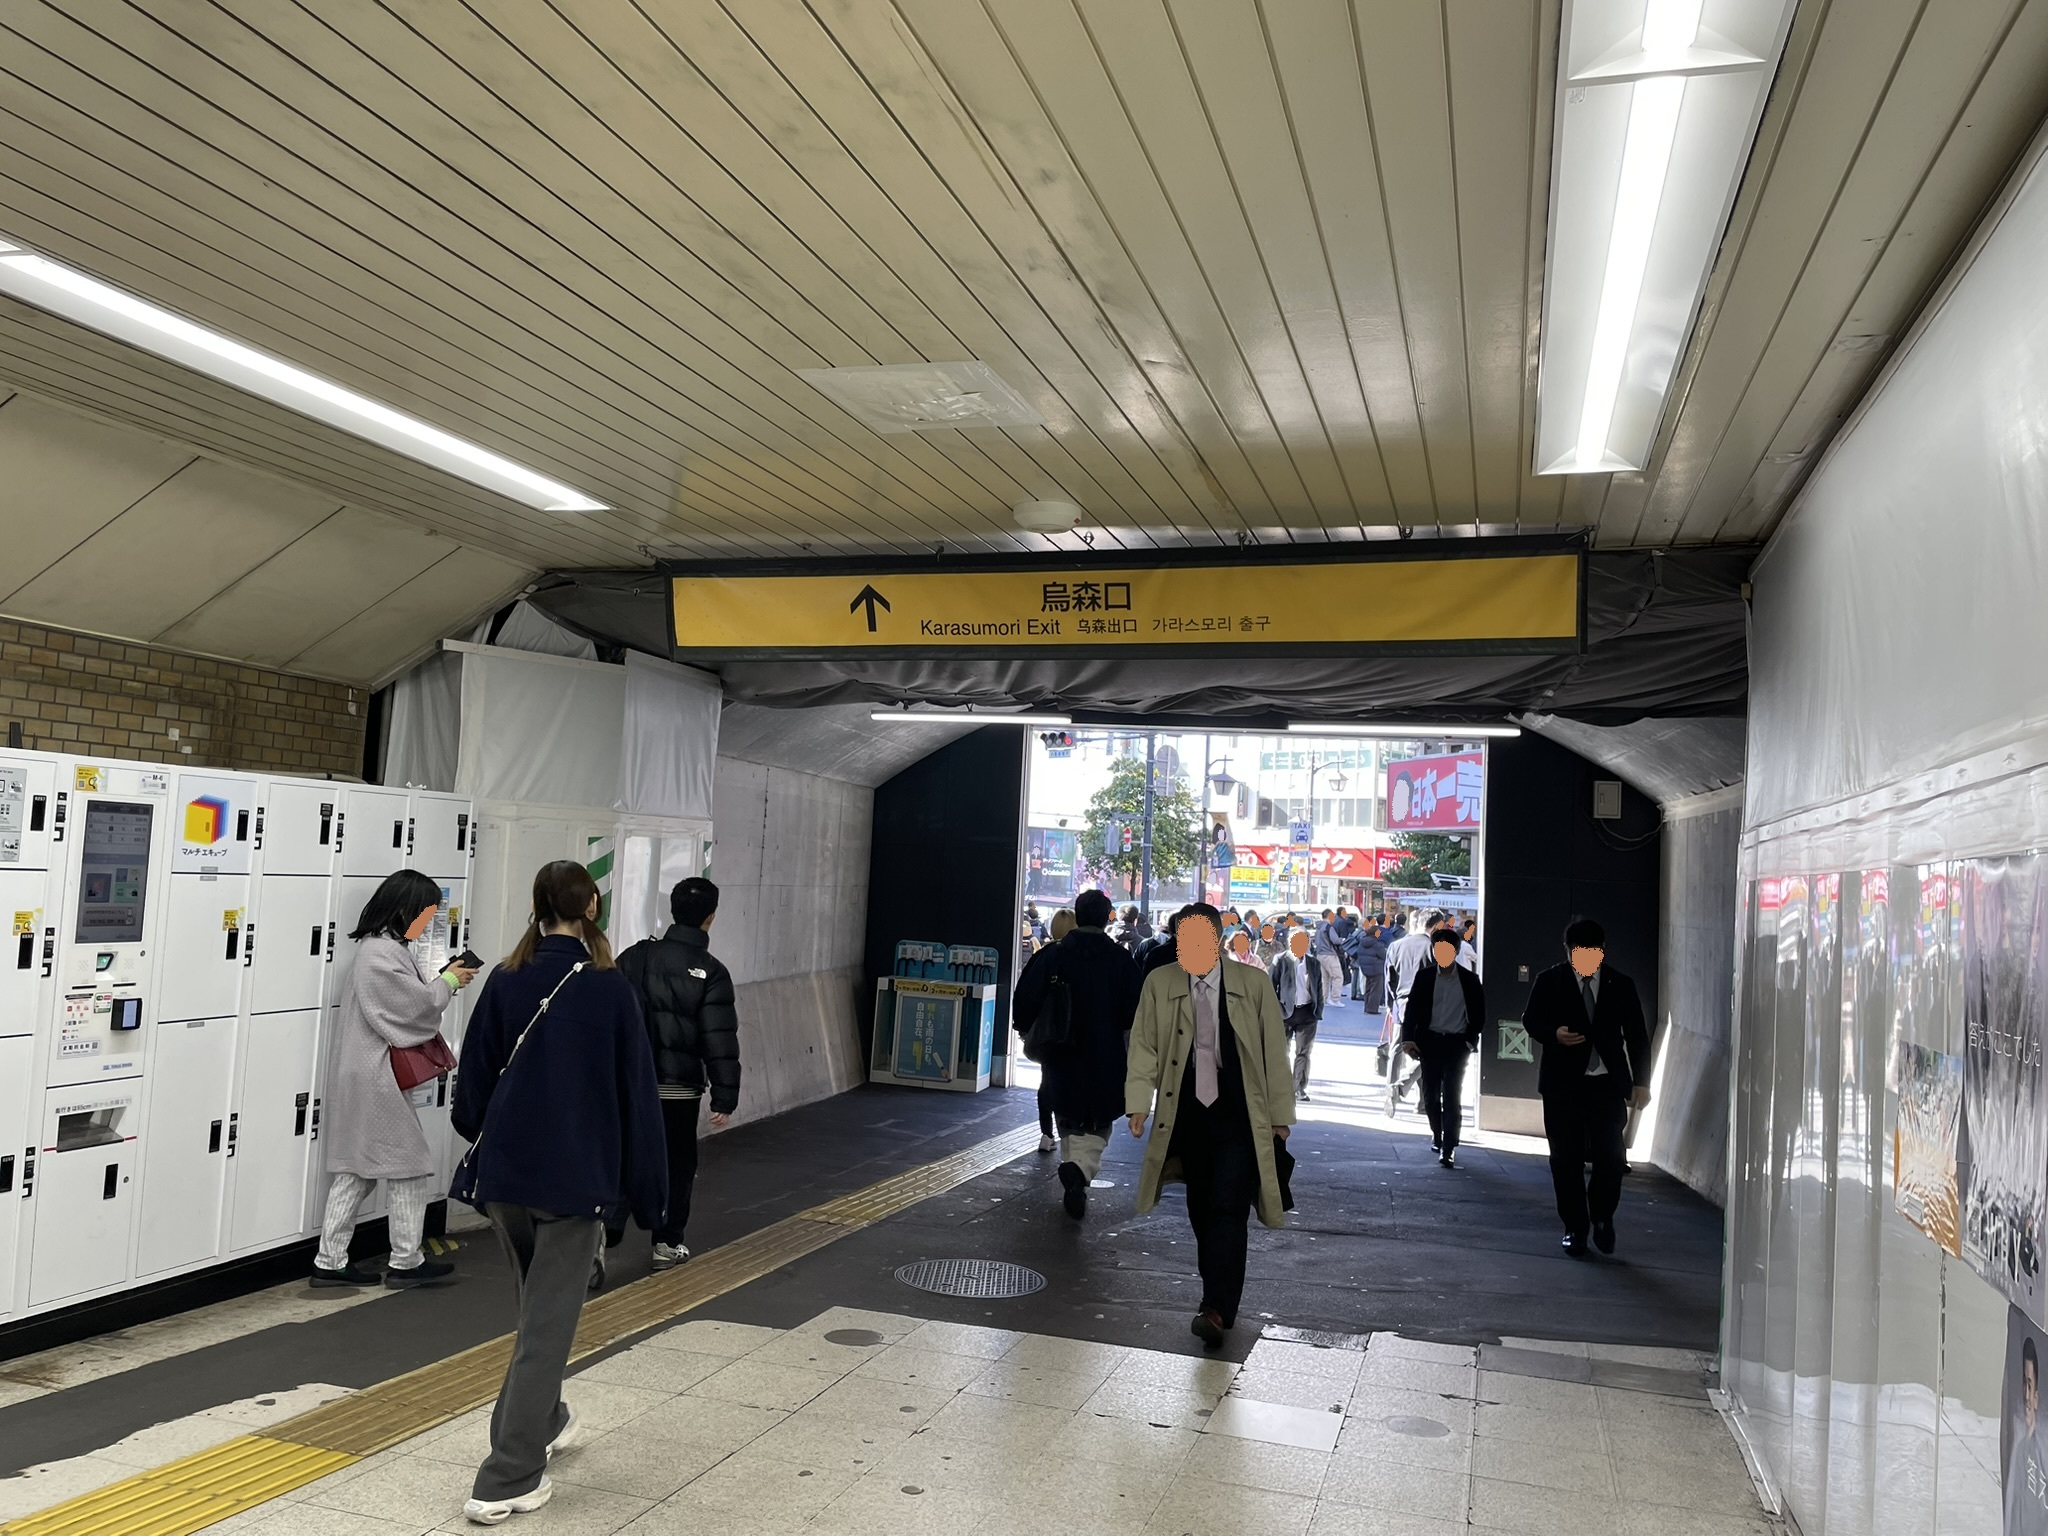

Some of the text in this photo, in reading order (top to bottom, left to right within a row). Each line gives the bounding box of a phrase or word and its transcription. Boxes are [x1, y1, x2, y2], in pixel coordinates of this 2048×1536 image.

[1040, 581, 1132, 612] 烏森口
[920, 616, 1272, 636] Karasumori Exit 乌森出口 가라스모리 출구
[1293, 822, 1311, 830] TAXI
[181, 848, 228, 857] マルチエキューブ
